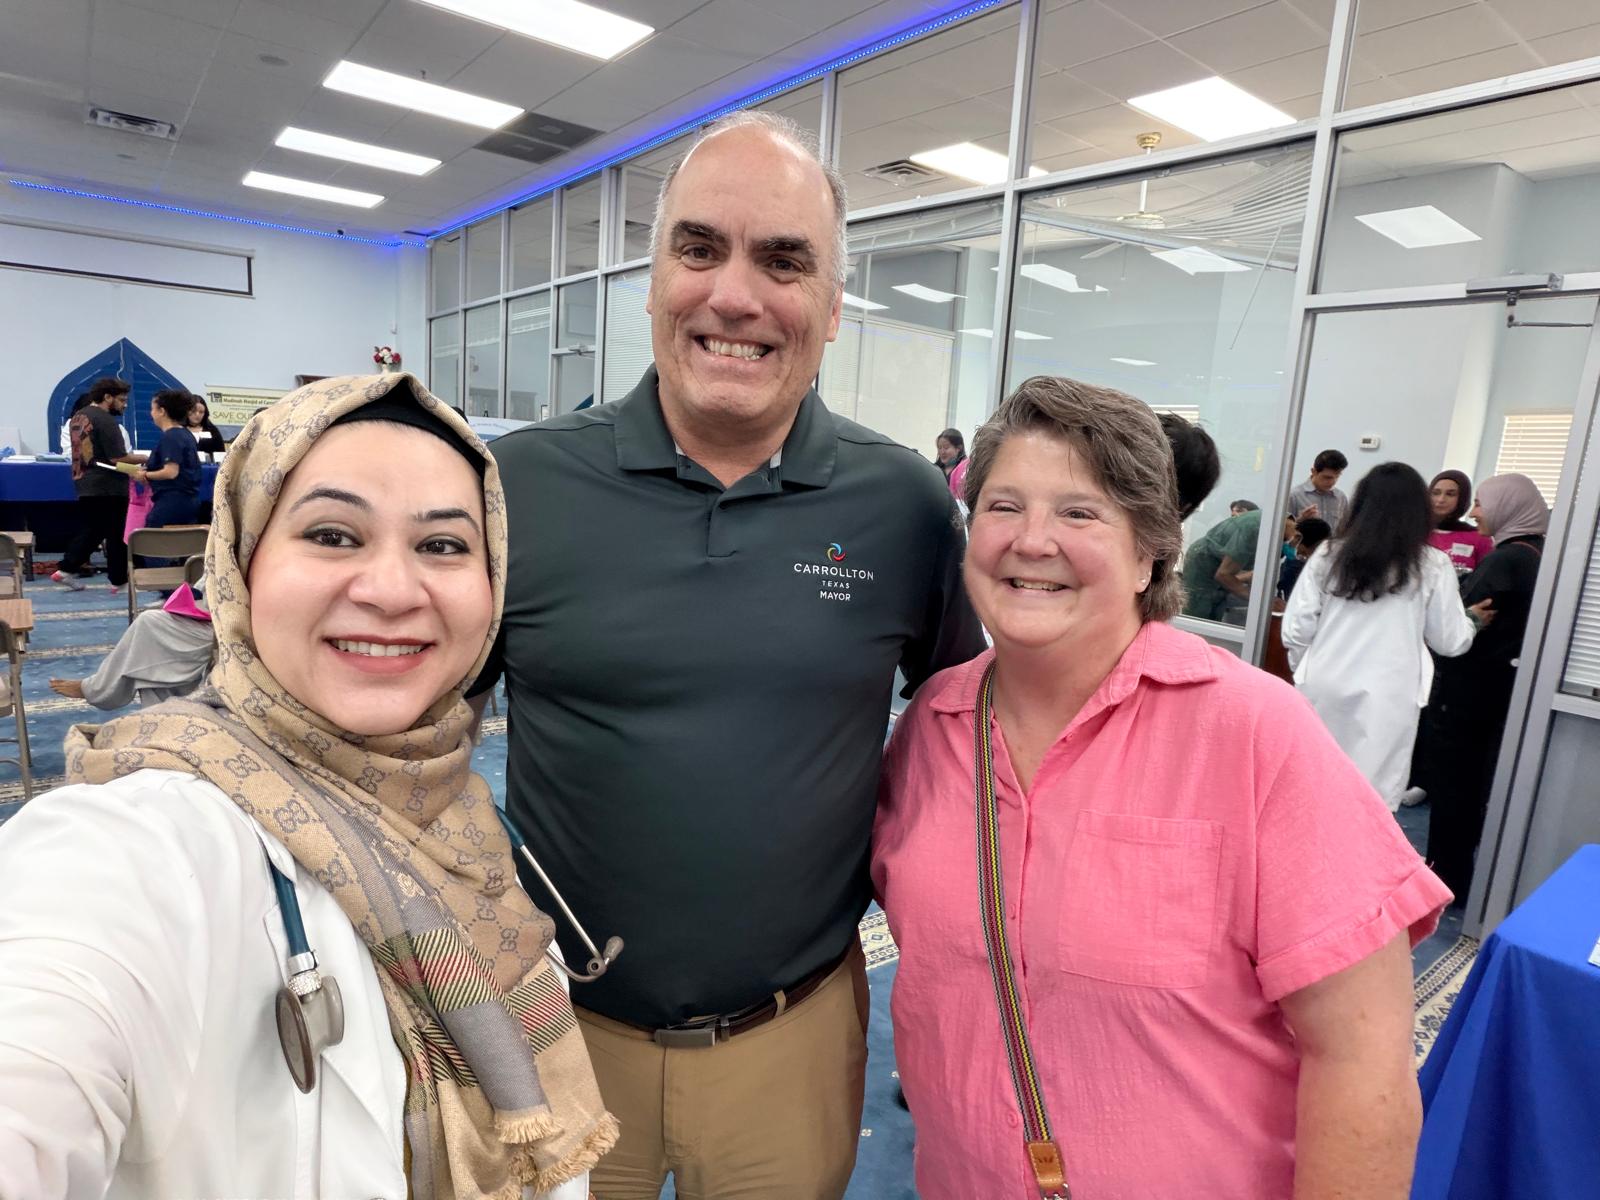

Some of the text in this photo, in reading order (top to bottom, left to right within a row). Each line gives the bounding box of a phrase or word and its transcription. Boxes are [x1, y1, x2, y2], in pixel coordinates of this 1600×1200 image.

[794, 563, 874, 581] CARROLLTON
[822, 580, 850, 589] TEXAS
[820, 590, 851, 601] MAYOR
